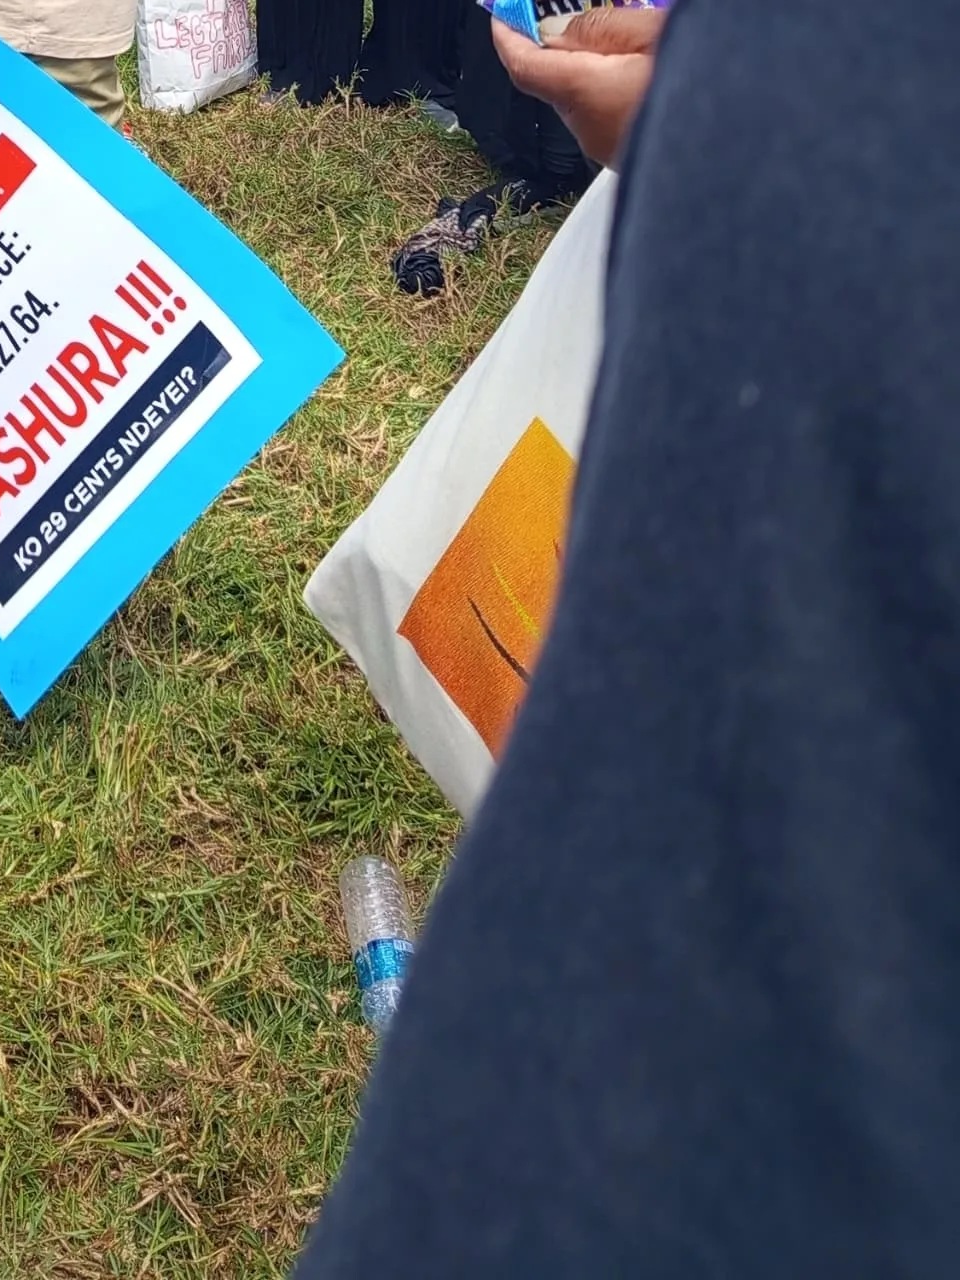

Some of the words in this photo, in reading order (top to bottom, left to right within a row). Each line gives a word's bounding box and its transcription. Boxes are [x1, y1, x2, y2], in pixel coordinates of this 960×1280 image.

[114, 259, 187, 336] !!!
[13, 536, 43, 573] KO
[40, 511, 68, 543] 29
[64, 447, 125, 514] CENTS
[118, 365, 199, 457] NDEYEI?
